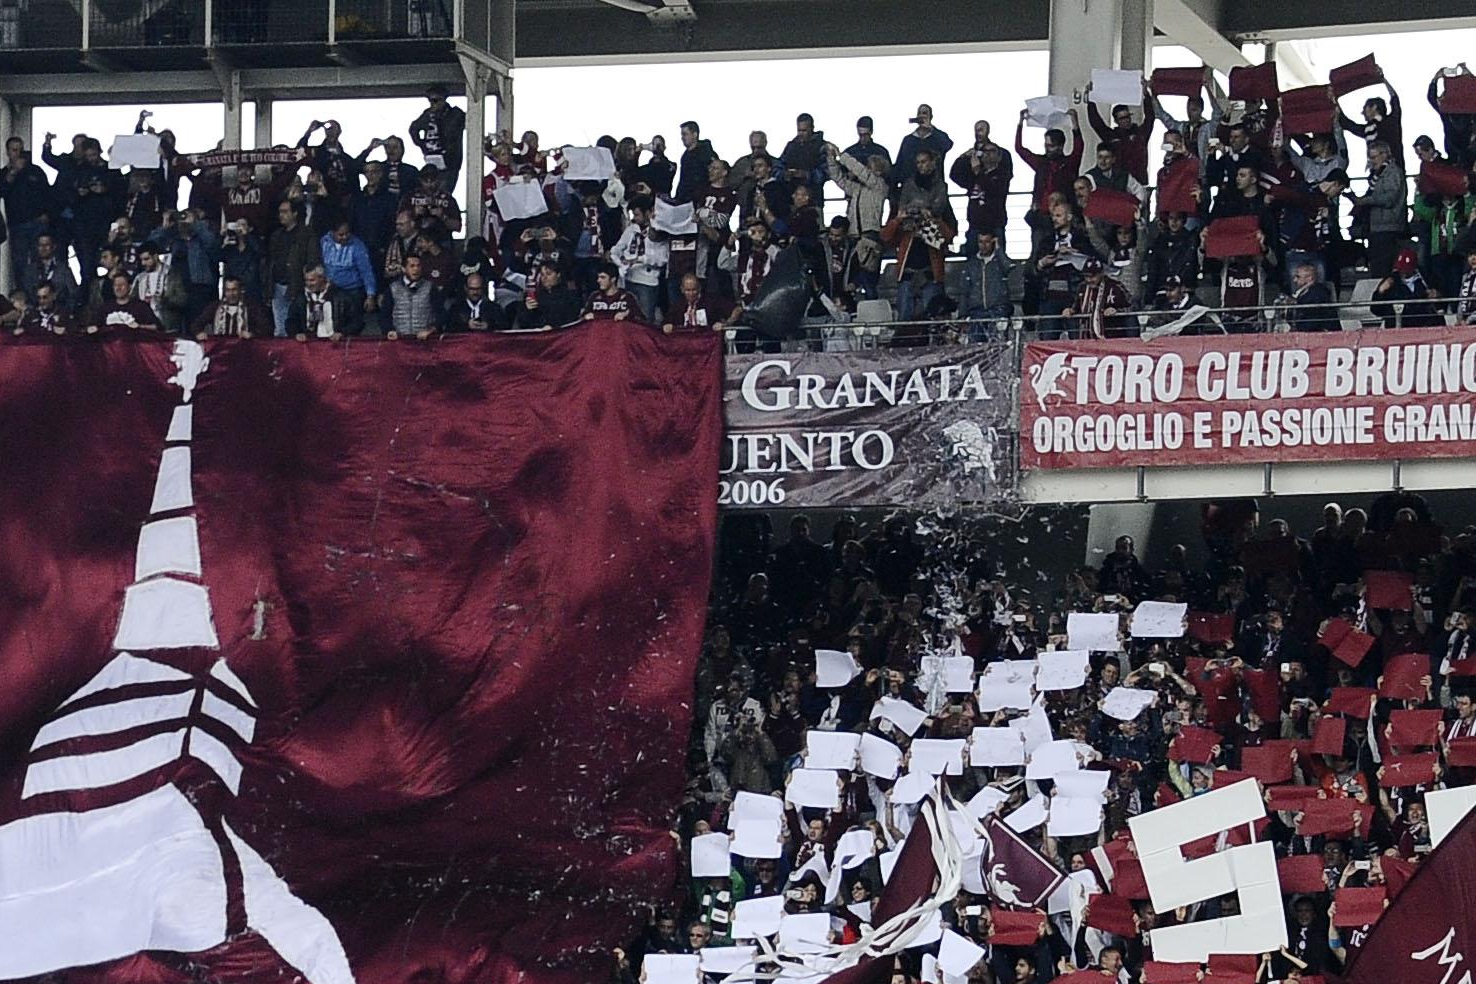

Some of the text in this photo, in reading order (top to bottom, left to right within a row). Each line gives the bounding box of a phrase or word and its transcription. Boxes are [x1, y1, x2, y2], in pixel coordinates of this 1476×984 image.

[741, 359, 991, 411] GRANATA
[1073, 352, 1184, 405] TORO
[1197, 347, 1310, 401] CLUB
[1033, 411, 1184, 454] ORGOGLIO
[1193, 411, 1212, 449] E
[1222, 406, 1375, 448] PASSIONE
[719, 478, 786, 504] 2006
